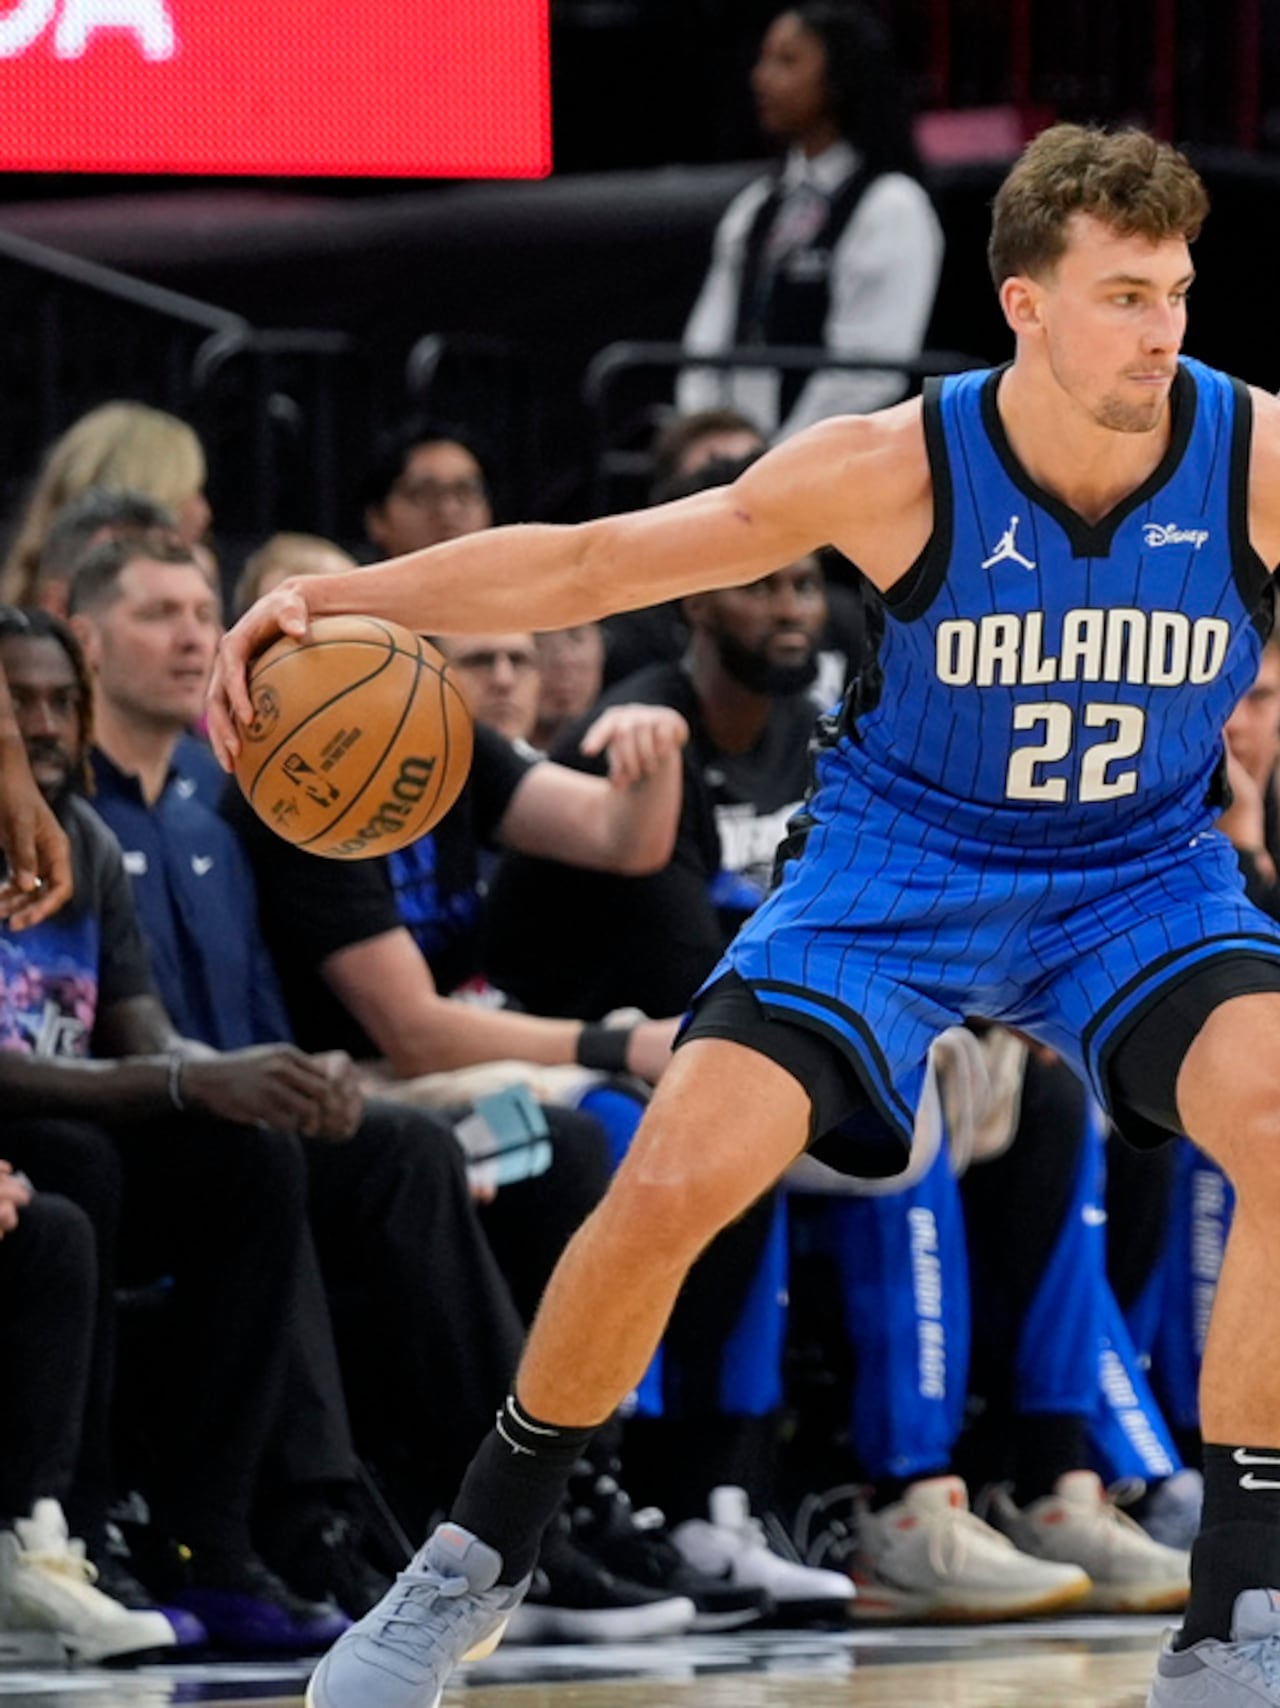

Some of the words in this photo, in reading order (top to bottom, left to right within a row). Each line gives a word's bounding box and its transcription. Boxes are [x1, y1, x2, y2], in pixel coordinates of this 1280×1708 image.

[1142, 523, 1209, 550] Disney
[936, 608, 1230, 687] ORLANDO
[1006, 701, 1145, 802] 22
